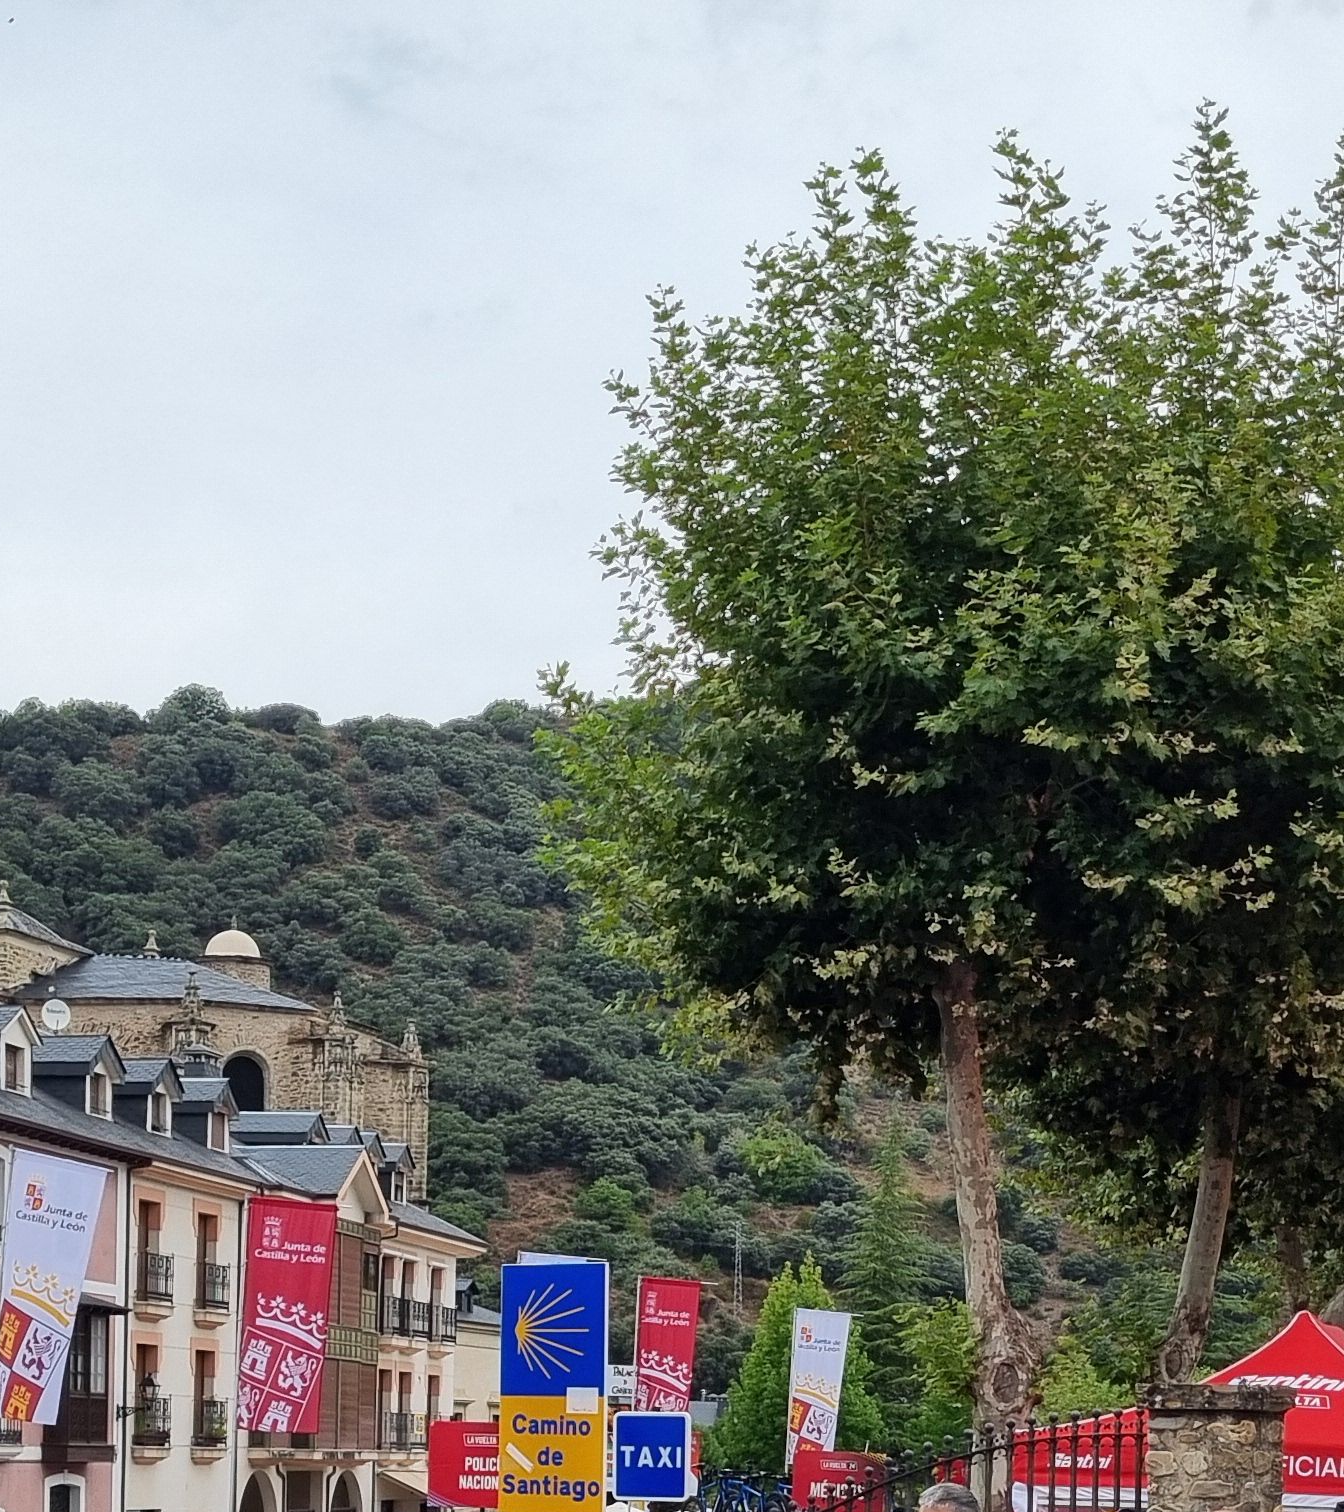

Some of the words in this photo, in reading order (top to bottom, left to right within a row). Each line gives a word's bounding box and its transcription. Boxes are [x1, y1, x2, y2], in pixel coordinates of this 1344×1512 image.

[16, 1209, 50, 1226] Castilla
[51, 1219, 59, 1230] y
[60, 1219, 86, 1233] León
[44, 1204, 73, 1218] Junta
[75, 1211, 88, 1222] de
[254, 1248, 290, 1261] Castilla
[291, 1254, 299, 1264] y
[300, 1252, 326, 1265] León
[282, 1241, 311, 1253] Junta
[313, 1244, 327, 1254] de
[511, 1413, 592, 1437] Camino
[467, 1436, 475, 1445] LA
[475, 1436, 498, 1445] VUELTA
[537, 1446, 564, 1467] de
[620, 1445, 683, 1469] TAXI
[458, 1474, 499, 1490] NACION
[501, 1474, 601, 1503] Santiago
